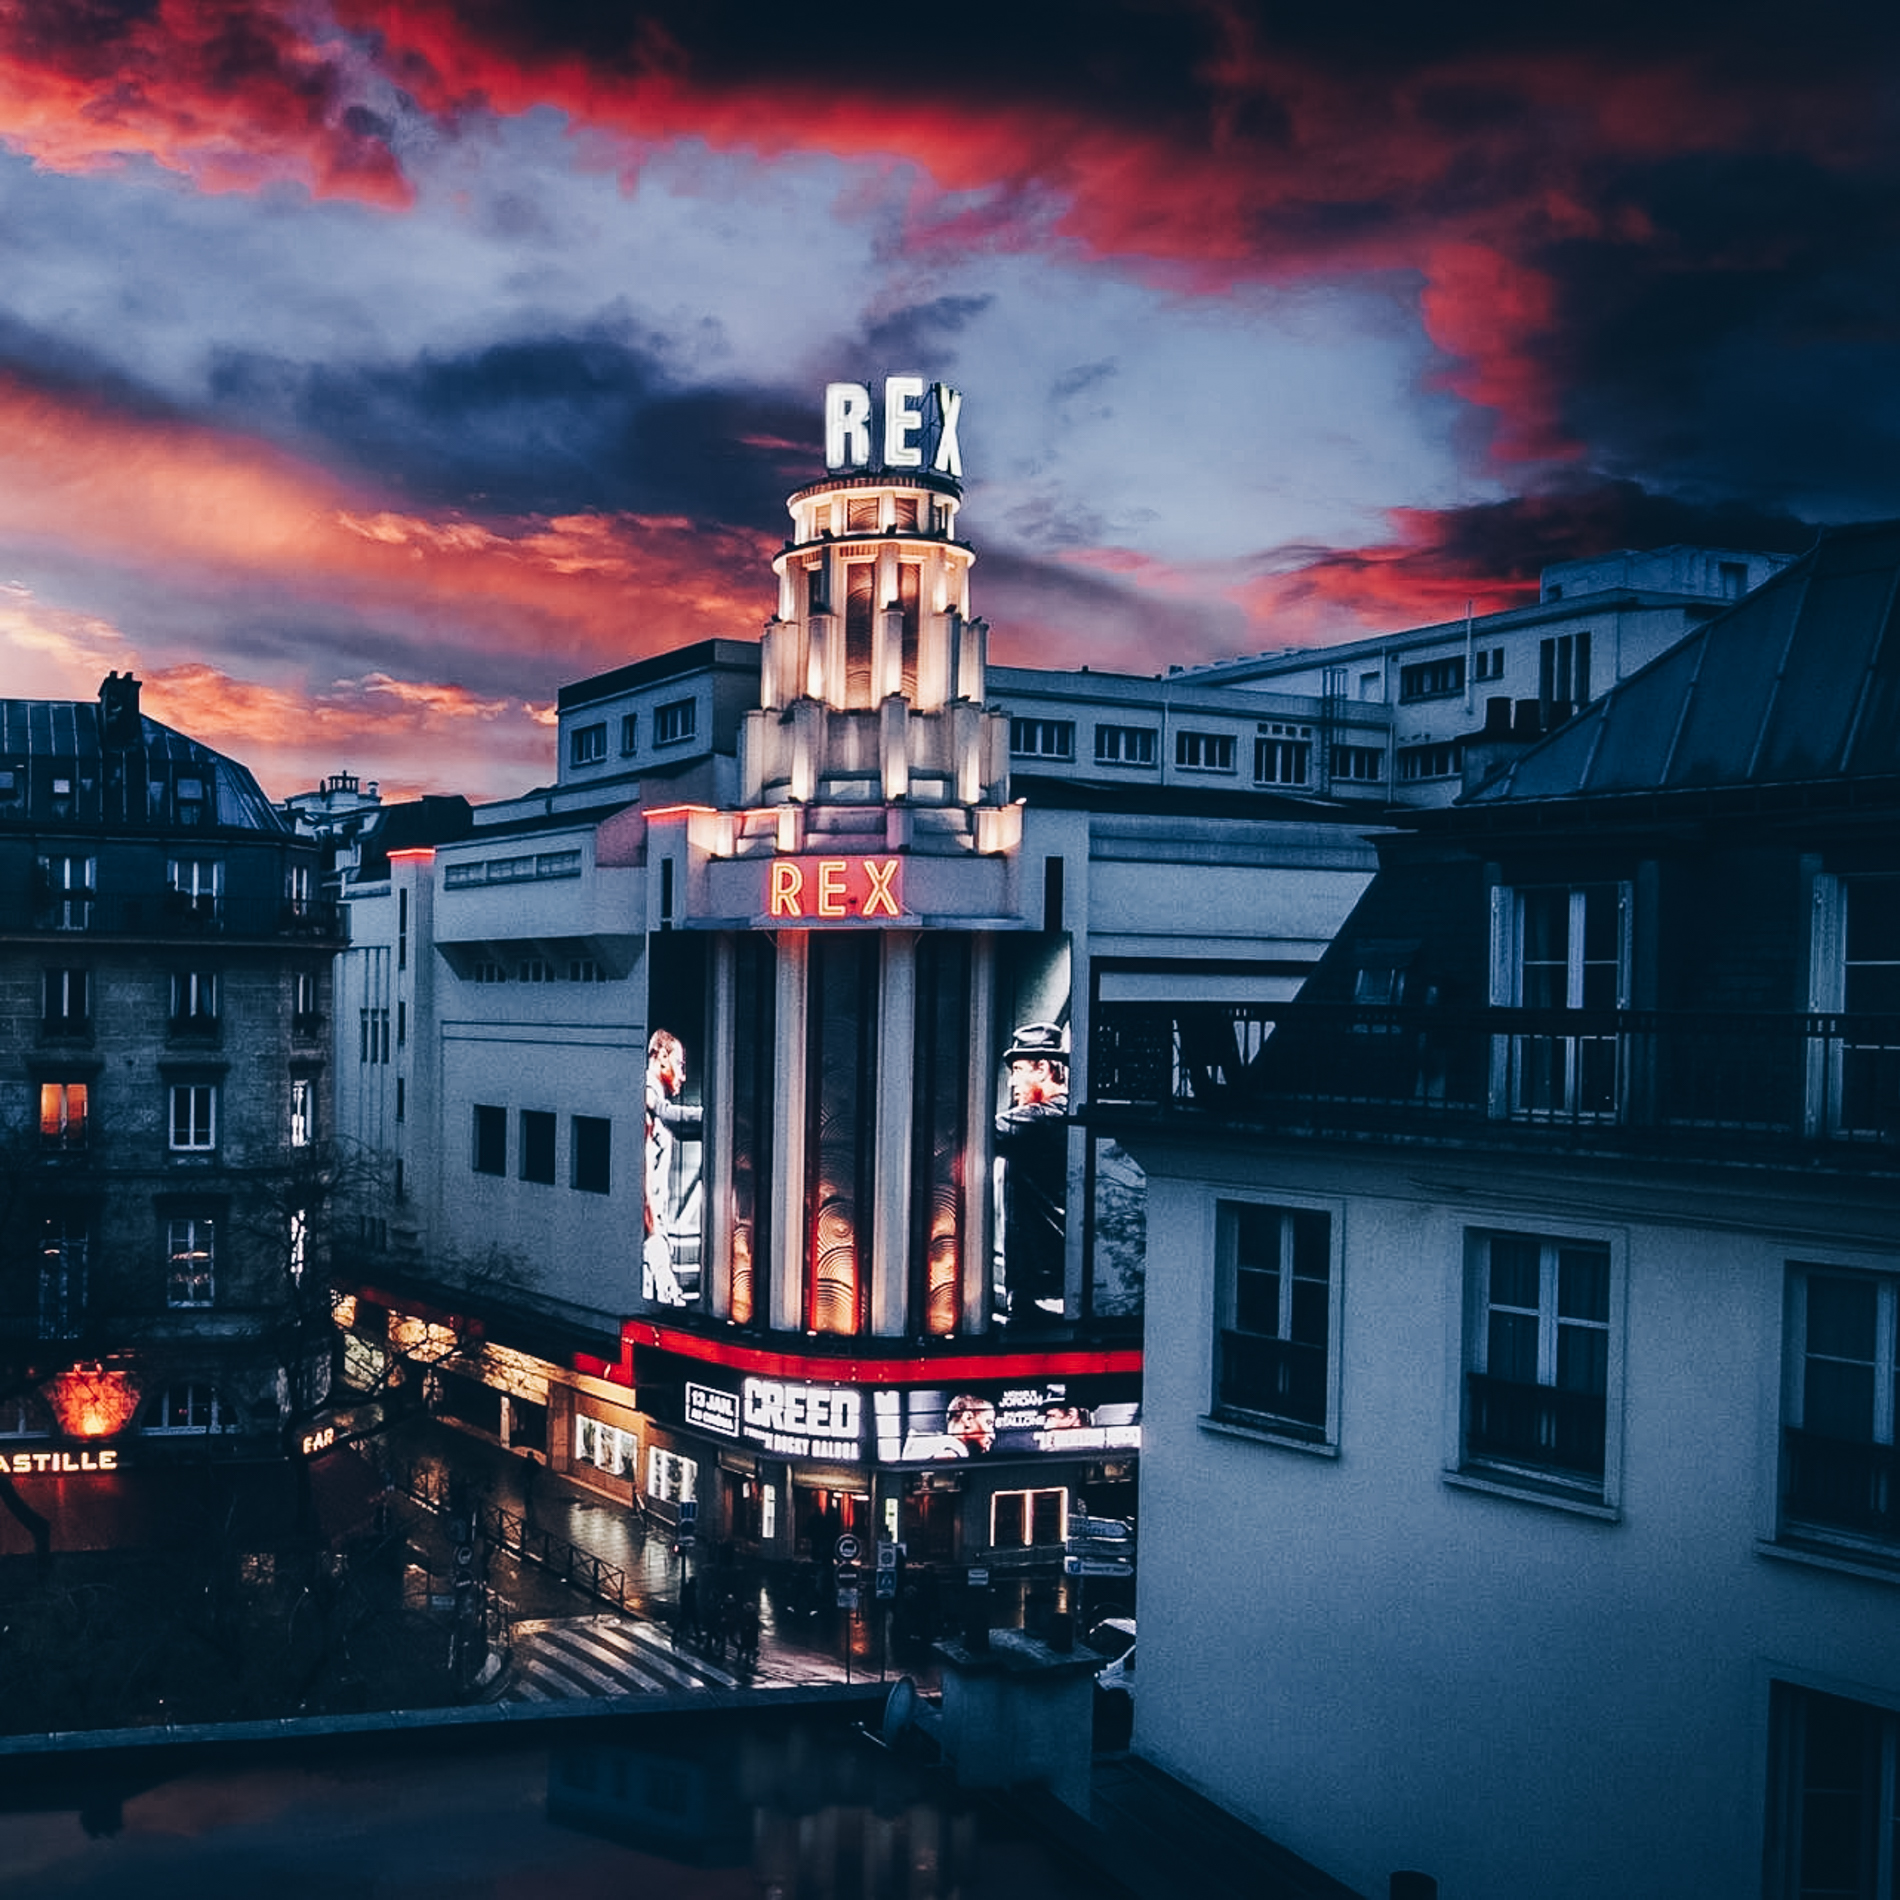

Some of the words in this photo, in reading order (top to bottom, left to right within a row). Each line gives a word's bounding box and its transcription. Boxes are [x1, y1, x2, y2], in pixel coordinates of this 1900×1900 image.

[825, 376, 963, 478] REX
[771, 859, 900, 916] REX
[744, 1377, 860, 1438] CREED
